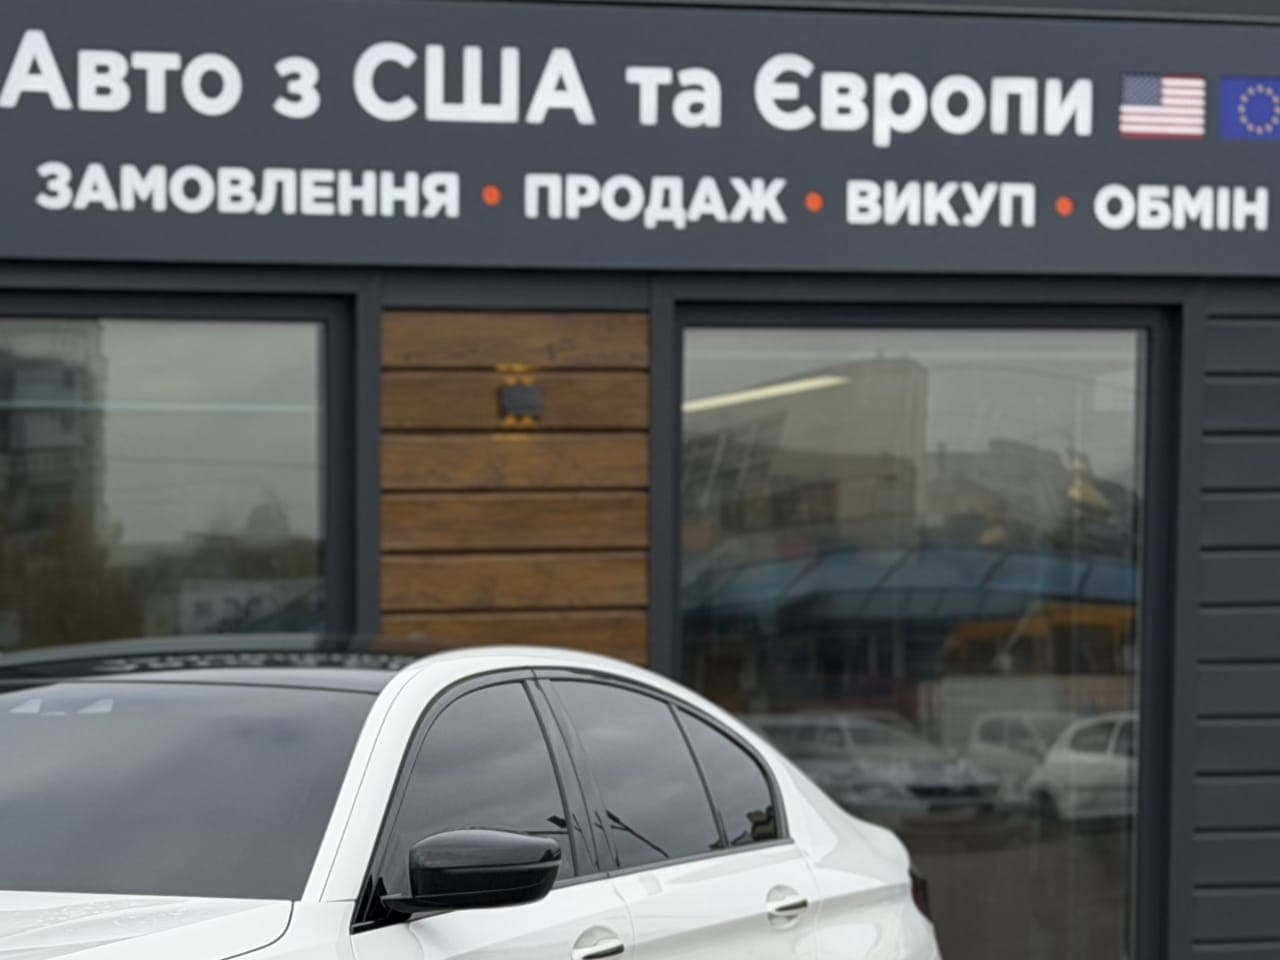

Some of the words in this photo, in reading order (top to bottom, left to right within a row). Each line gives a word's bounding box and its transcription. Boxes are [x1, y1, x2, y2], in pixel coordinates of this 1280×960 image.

[273, 56, 321, 119] з
[353, 41, 596, 126] США
[625, 65, 722, 129] та
[754, 53, 1094, 148] Європи
[35, 161, 460, 219] ЗАМОВЛЕННЯ
[524, 172, 787, 230] ПРОДАЖ
[845, 179, 1036, 228] ВИКУП
[1093, 183, 1269, 231] ОБМІН
